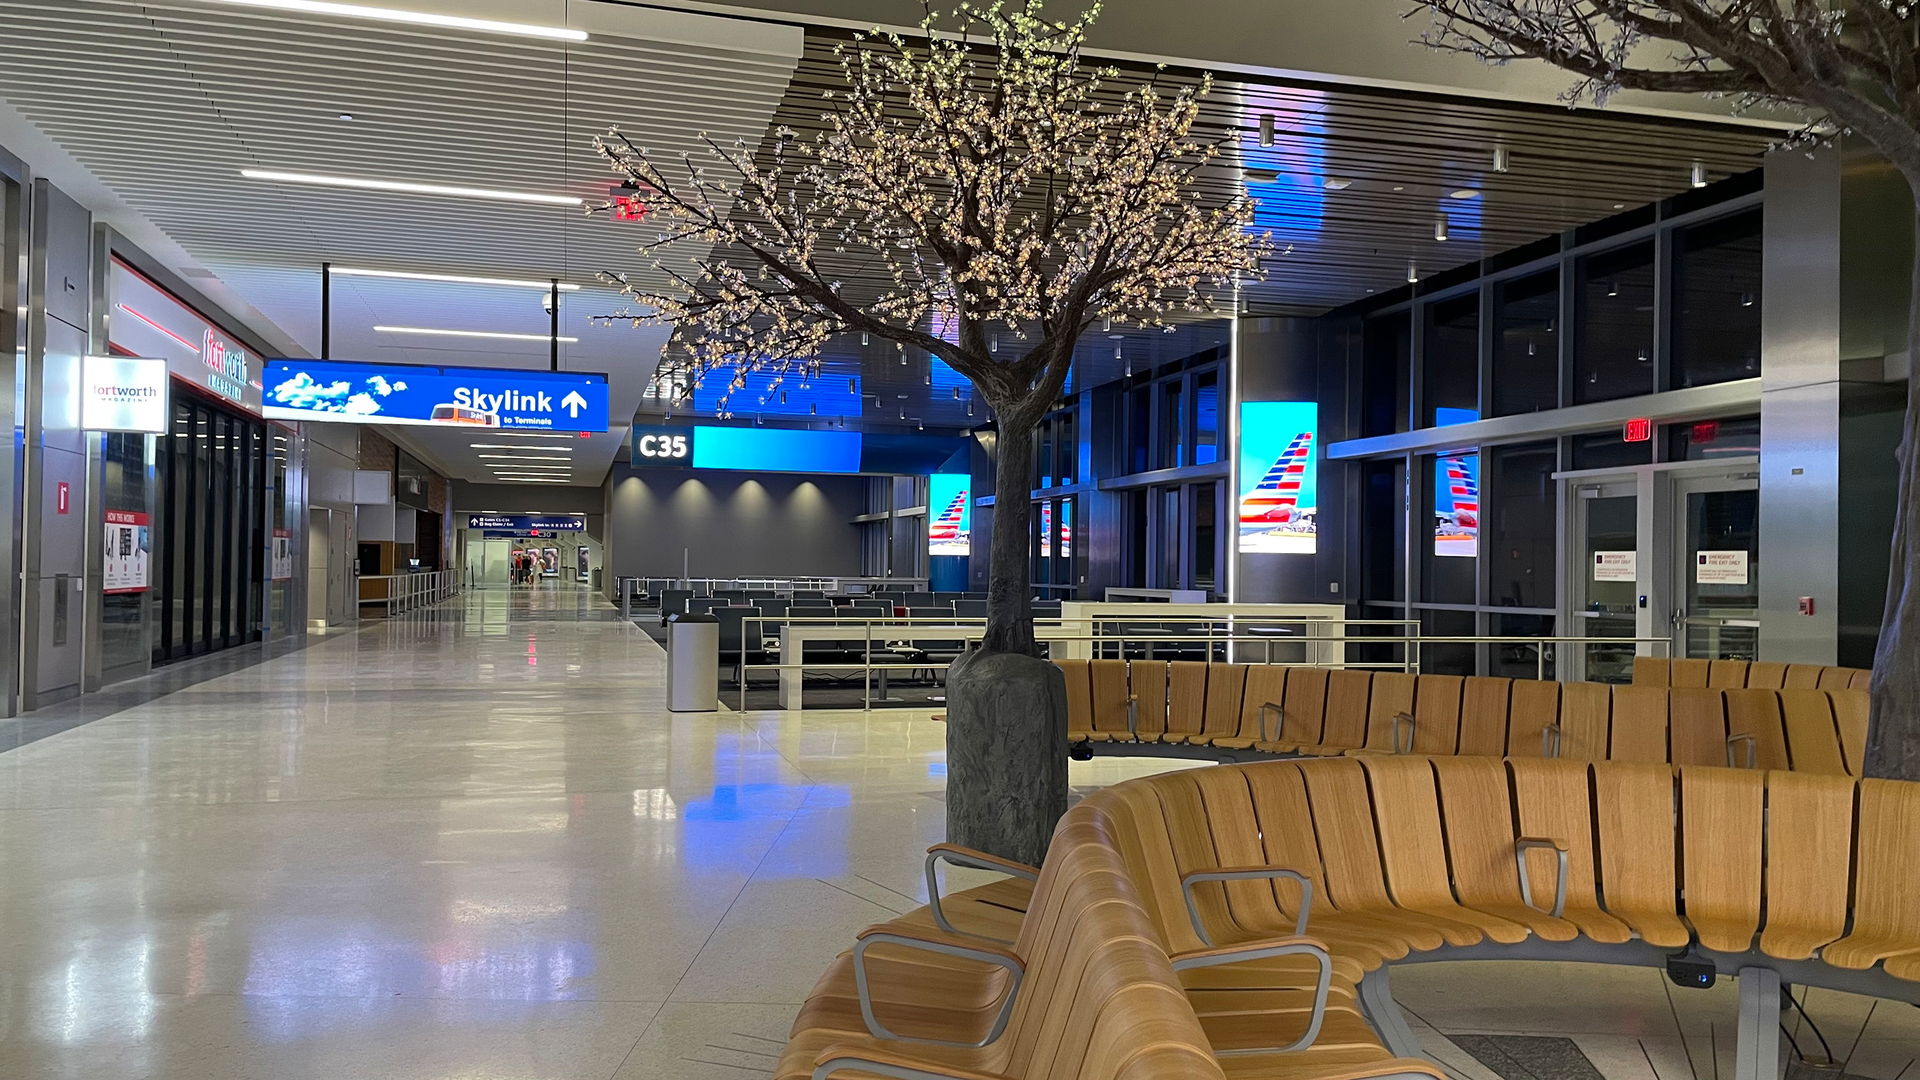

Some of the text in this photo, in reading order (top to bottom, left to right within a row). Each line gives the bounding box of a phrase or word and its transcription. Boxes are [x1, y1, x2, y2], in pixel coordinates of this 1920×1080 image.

[453, 386, 552, 415] Skylink
[503, 416, 553, 426] to Terminals
[1627, 421, 1647, 439] EXIT
[639, 434, 687, 458] C35
[107, 512, 116, 521] HOW
